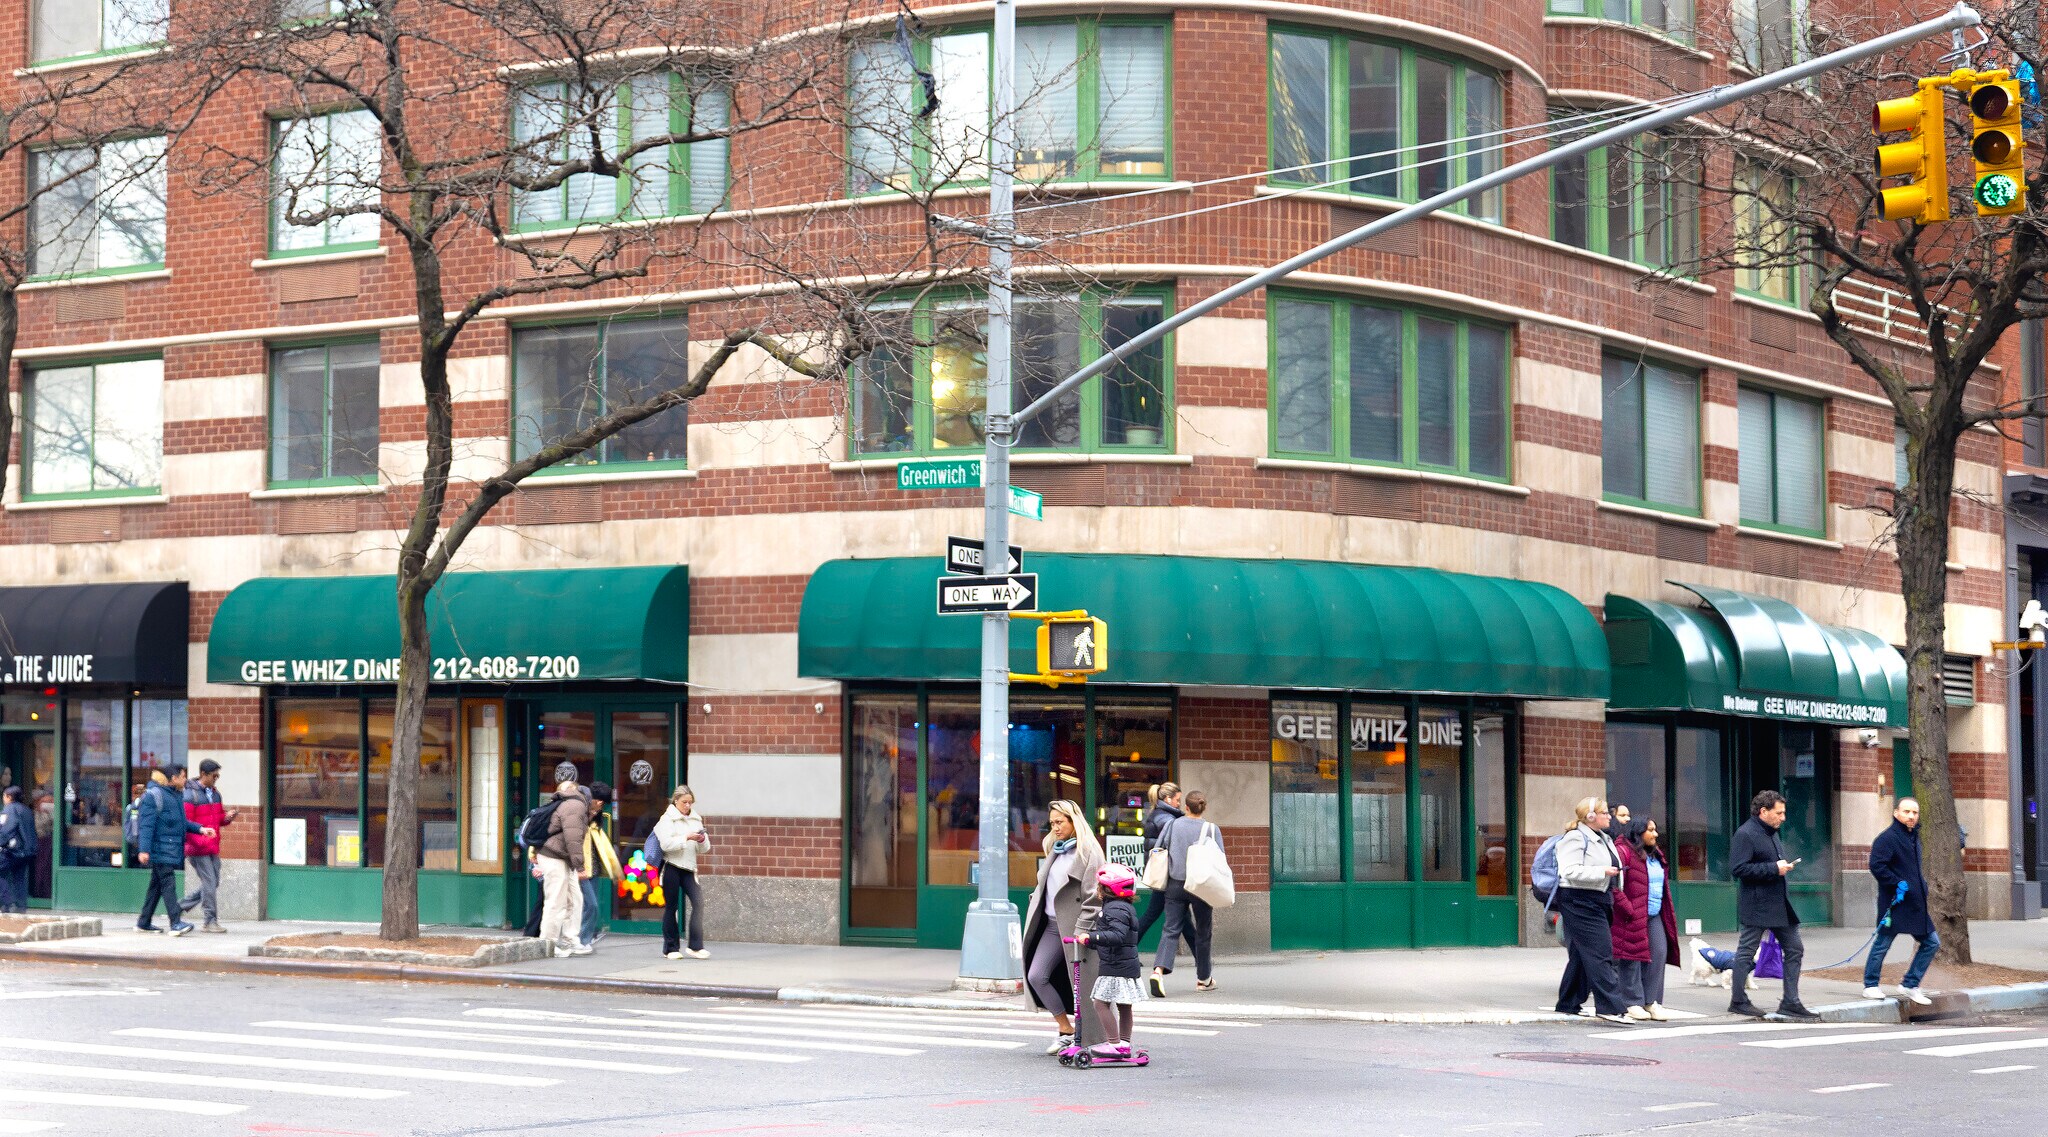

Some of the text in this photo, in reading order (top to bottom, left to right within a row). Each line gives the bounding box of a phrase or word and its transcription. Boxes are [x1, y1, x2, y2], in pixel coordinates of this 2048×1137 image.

[901, 463, 980, 486] Greenwich St
[958, 548, 980, 565] ONE
[952, 587, 1021, 602] ONE WAY
[14, 655, 43, 683] THE
[47, 655, 93, 683] JUICE
[240, 656, 580, 682] GEE WHIZ DINE 212-608-7200
[1763, 697, 1784, 714] GEE
[1785, 699, 1809, 717] WHIZ
[1276, 715, 1332, 739] GEE
[1350, 717, 1408, 743] WHIZ
